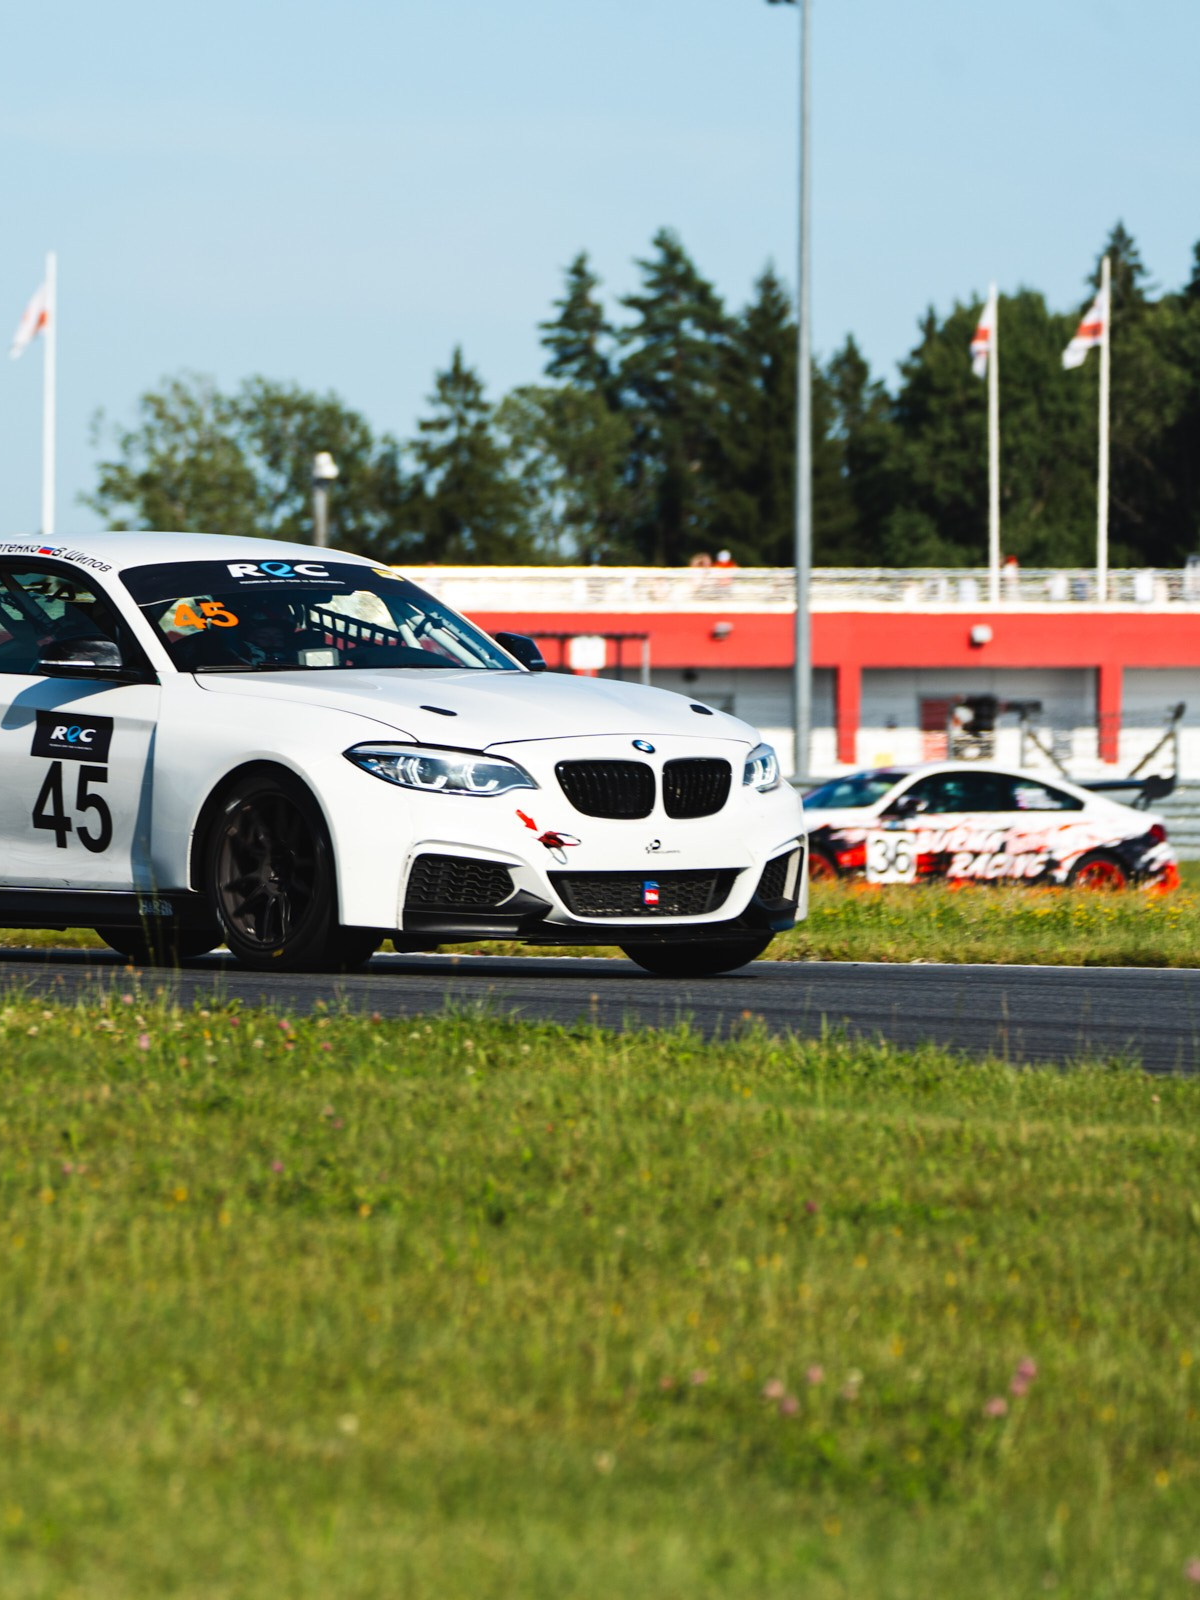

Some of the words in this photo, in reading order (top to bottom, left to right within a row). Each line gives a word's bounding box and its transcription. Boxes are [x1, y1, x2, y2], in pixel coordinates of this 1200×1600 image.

[51, 547, 112, 573] В.Шилов
[174, 601, 239, 629] 45
[31, 760, 113, 853] 45
[869, 839, 911, 874] 36
